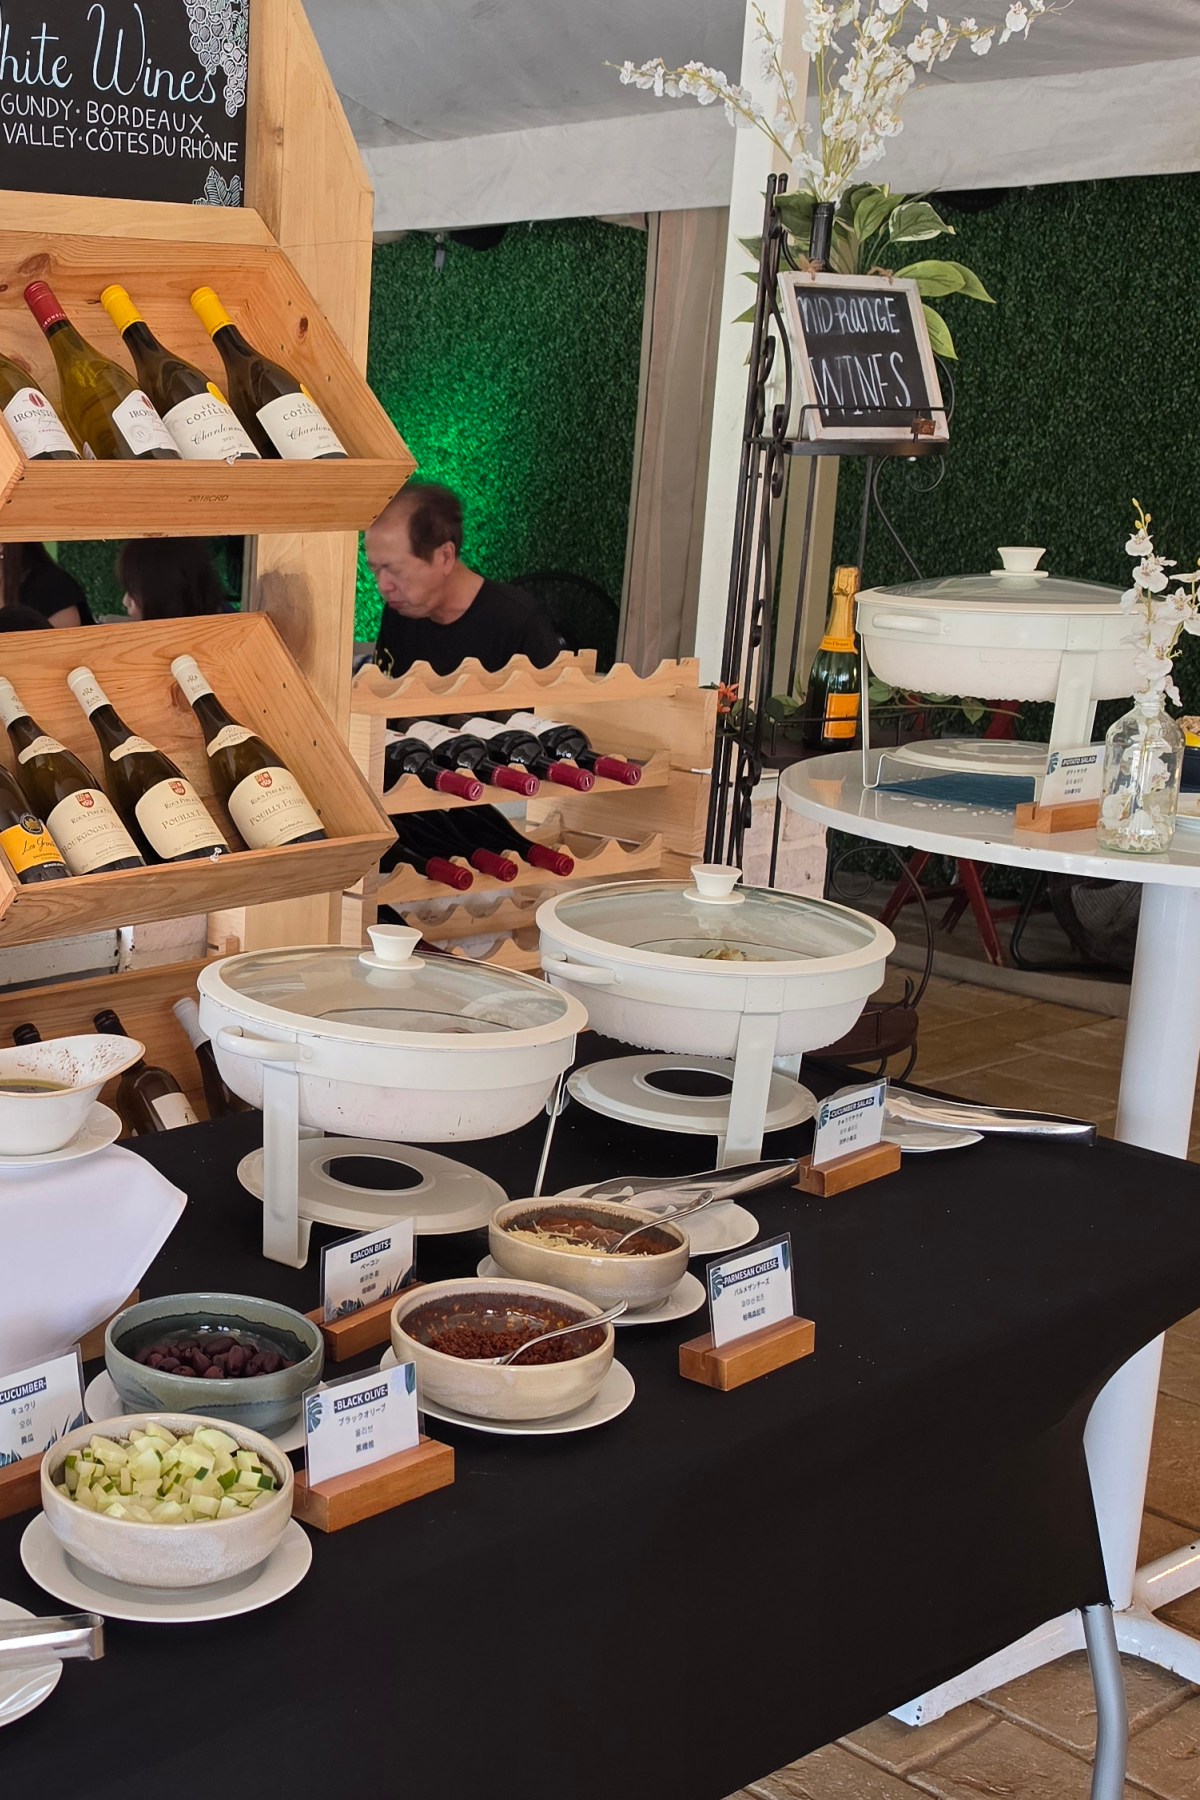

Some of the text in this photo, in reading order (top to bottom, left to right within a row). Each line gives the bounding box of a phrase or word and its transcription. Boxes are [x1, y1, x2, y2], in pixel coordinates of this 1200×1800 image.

[87, 2, 217, 104] Wines
[87, 100, 205, 134] BORDEAUX
[2, 122, 78, 149] VALLEY
[152, 137, 177, 158] DU
[180, 133, 239, 164] RHÔNE
[808, 351, 912, 419] WINES
[10, 1400, 37, 1416] キュウリ
